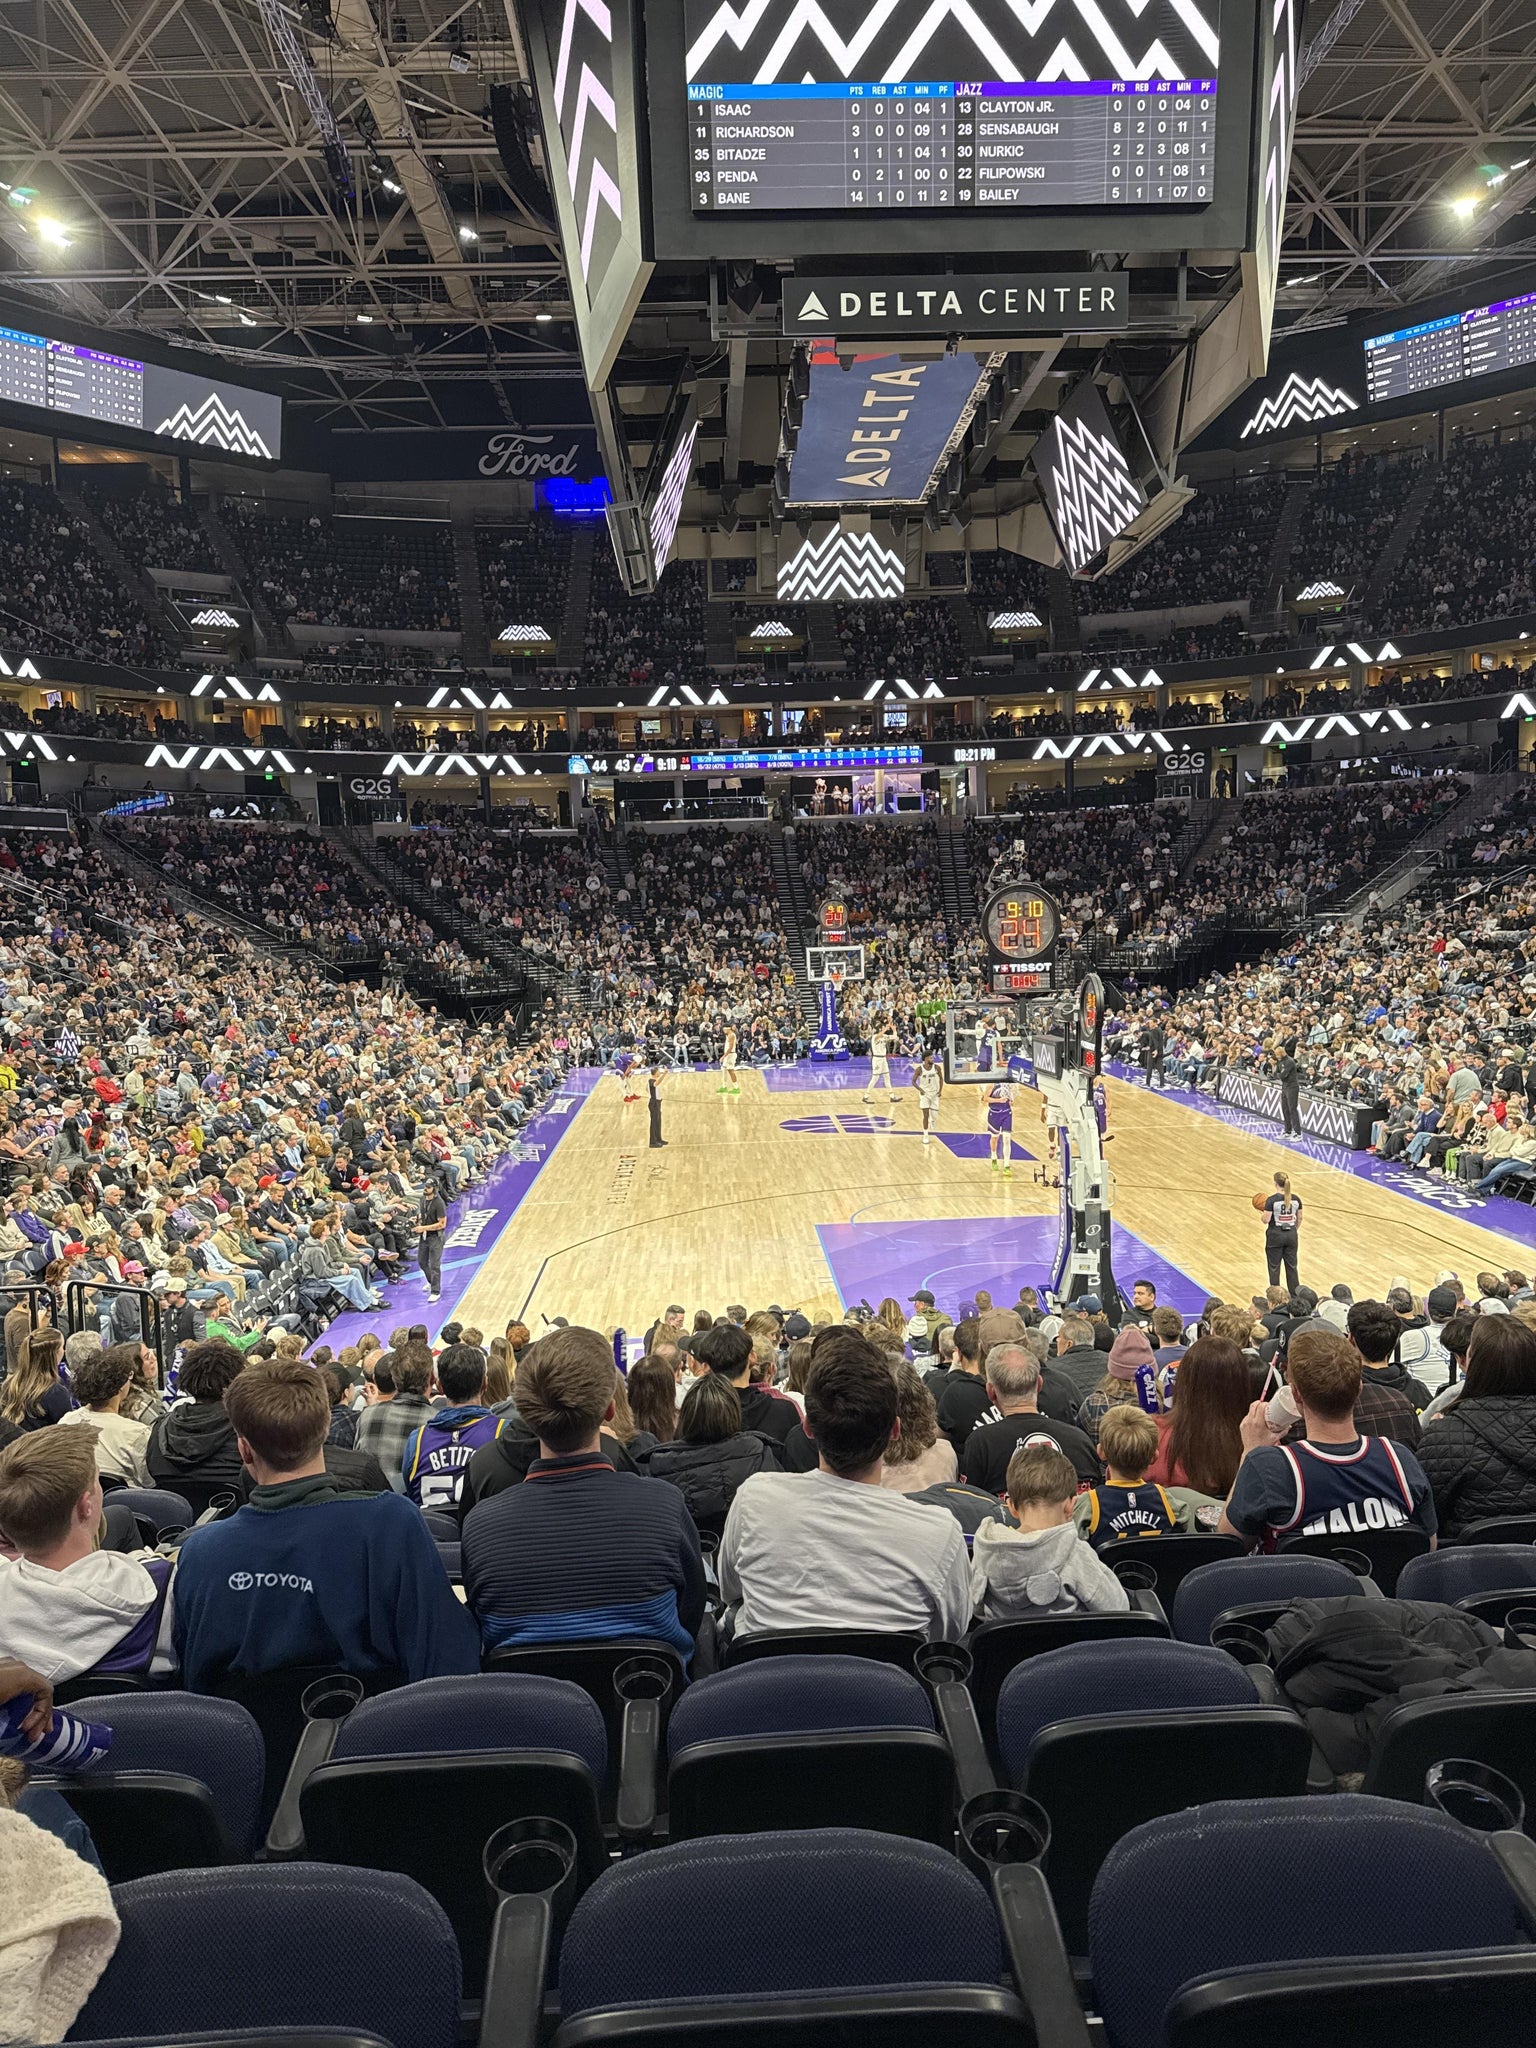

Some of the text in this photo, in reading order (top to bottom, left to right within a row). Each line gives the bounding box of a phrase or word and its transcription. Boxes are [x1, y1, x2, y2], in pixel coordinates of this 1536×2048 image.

[689, 86, 722, 100] MAGIC
[850, 87, 863, 95] PTS
[872, 86, 886, 94] REB
[893, 86, 906, 94] AST
[915, 86, 928, 94] MIN
[957, 82, 1210, 95] JAZZ PTS REB AST MIN PF
[698, 103, 945, 116] 1 ISAAC 0 0 0 04 1
[959, 99, 1208, 113] 13 CLAYTON JR. 0 0 0 04 0
[697, 125, 945, 138] 11 RICHARDSON 3 0 0 09 1
[958, 121, 1206, 135] 28 SENSABAUGH 8 2 0 11 1
[695, 147, 945, 160] 35 BITADZE 1 1 1 04 1
[958, 143, 1205, 157] 30 NURKIC 2 2 3 08 1
[695, 169, 947, 182] 93 PENDA 0 2 1 00 0
[958, 165, 1204, 179] 22 FILIPOWSKI 0 0 1 08 1
[700, 190, 947, 204] 3 BANE 14 1 0 11 2
[959, 186, 1205, 200] 19 BAILEY 5 1 1 07 0
[840, 287, 1116, 317] DELTA CENTER
[845, 365, 927, 463] DELTA
[478, 433, 580, 476] Ford
[955, 748, 995, 761] 08:21 PM
[1164, 752, 1205, 769] G2G
[592, 760, 608, 772] 44
[615, 759, 630, 772] 43
[657, 758, 677, 771] 9:10
[350, 778, 391, 794] G2G
[1008, 901, 1043, 918] 9:10
[825, 913, 843, 926] 24
[1001, 919, 1041, 950] 24
[1010, 963, 1052, 972] TISSOT
[1052, 1212, 1064, 1281] AMERICA
[1109, 1510, 1161, 1532] MITCHELL
[255, 1573, 314, 1594] TOYOTA
